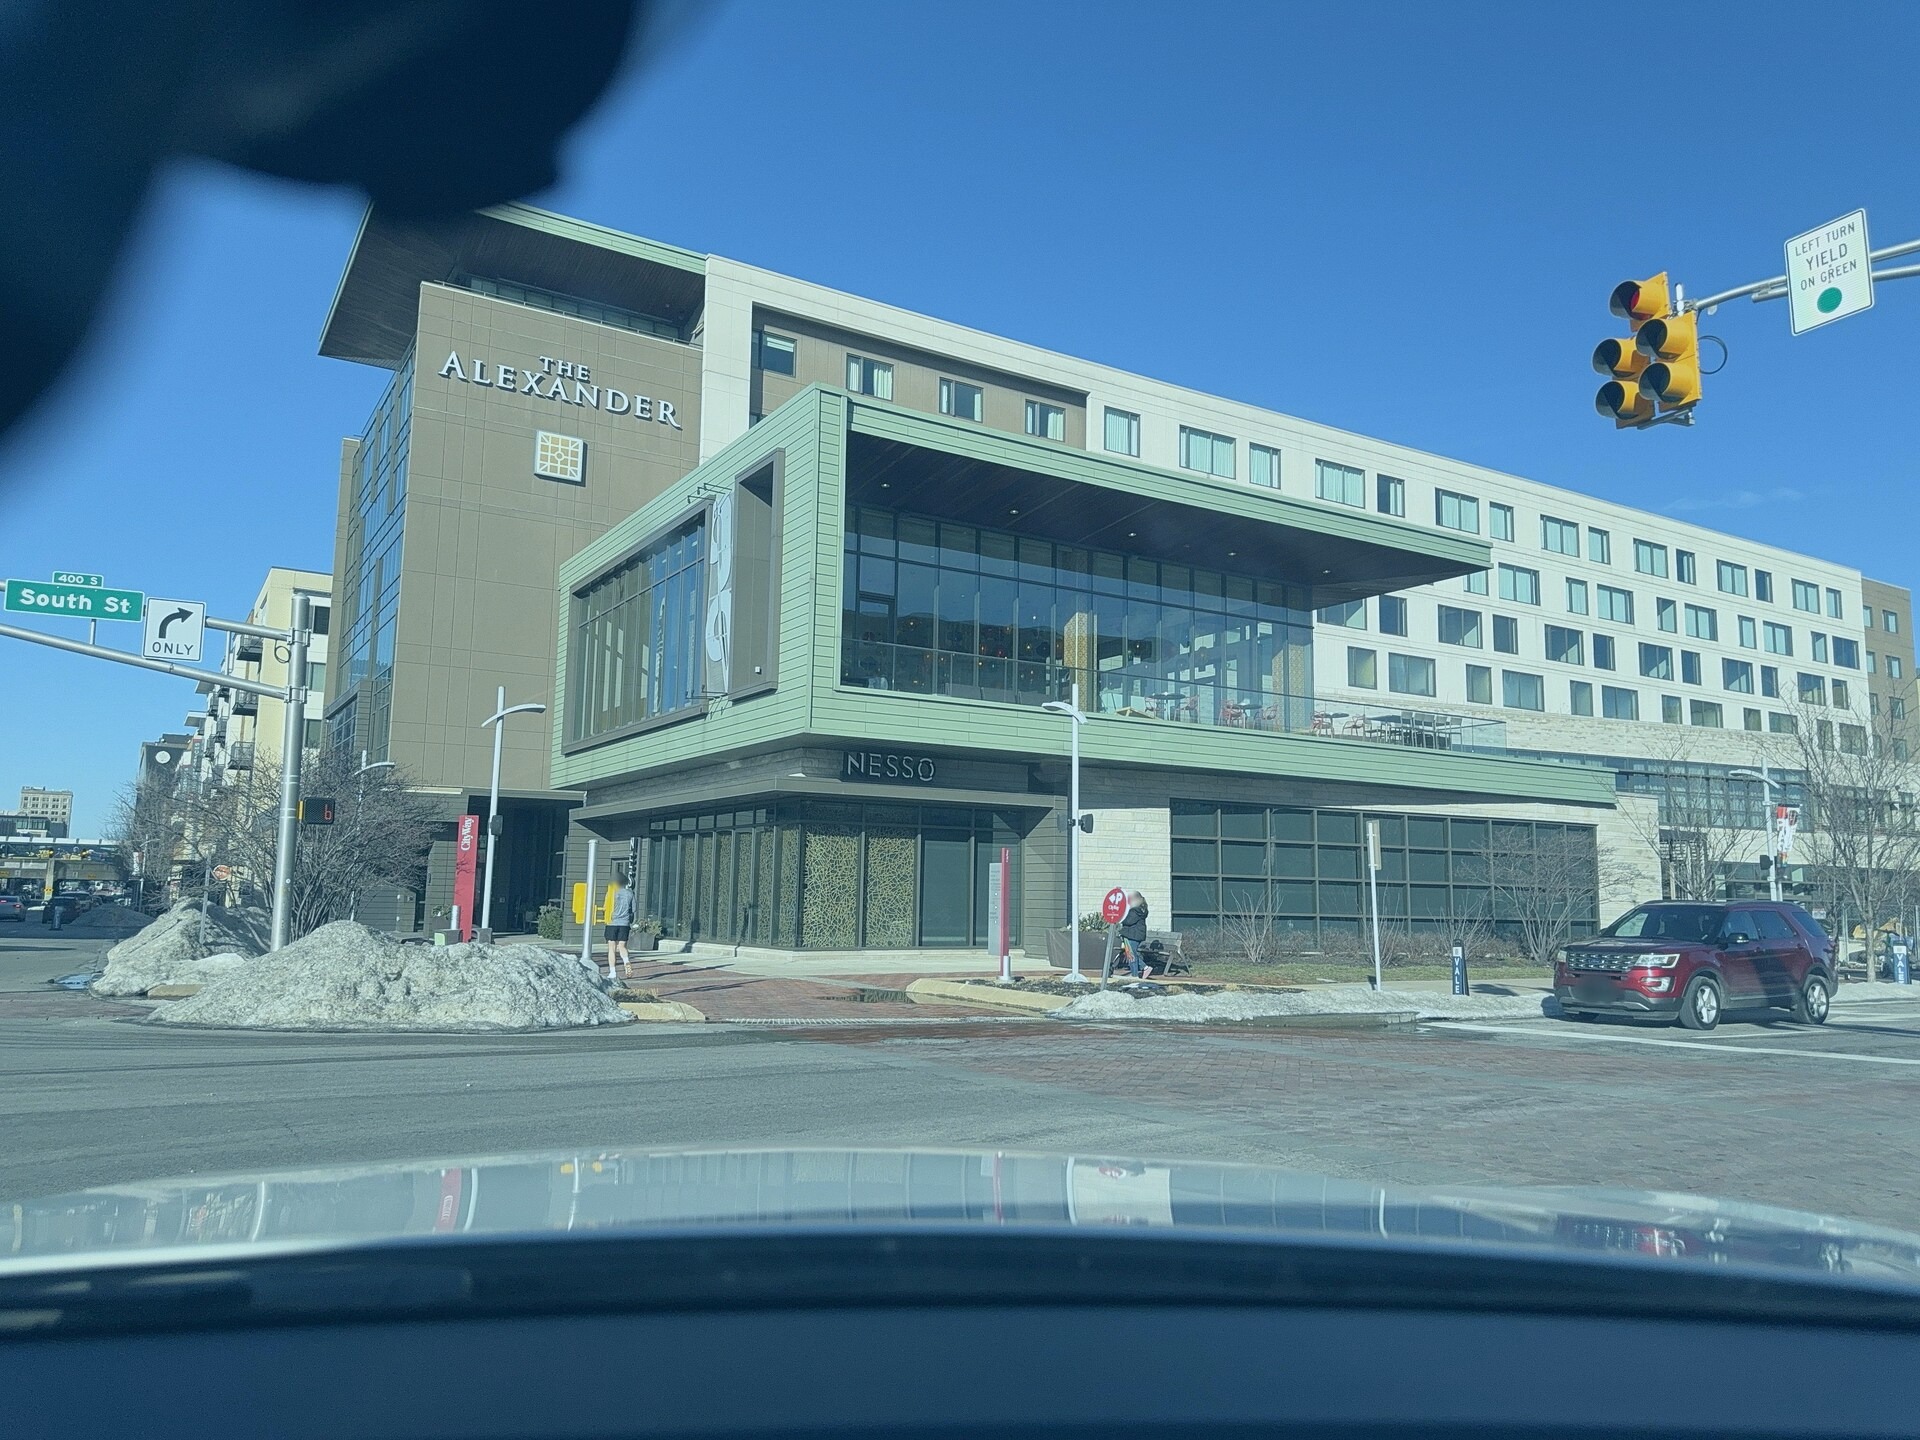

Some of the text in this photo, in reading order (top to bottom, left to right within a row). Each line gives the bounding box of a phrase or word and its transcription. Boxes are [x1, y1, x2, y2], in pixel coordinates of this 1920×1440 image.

[1795, 221, 1855, 257] LEFT TURN
[1806, 243, 1848, 271] YIELD
[1800, 259, 1857, 291] ON GREEN
[539, 355, 590, 381] THE
[438, 350, 683, 430] ALEXANDER
[58, 574, 98, 586] 400 S
[20, 588, 131, 614] South St
[152, 641, 194, 656] ONLY
[847, 752, 935, 782] NESSO
[461, 816, 474, 851] CityWay
[1896, 953, 1905, 984] VALE
